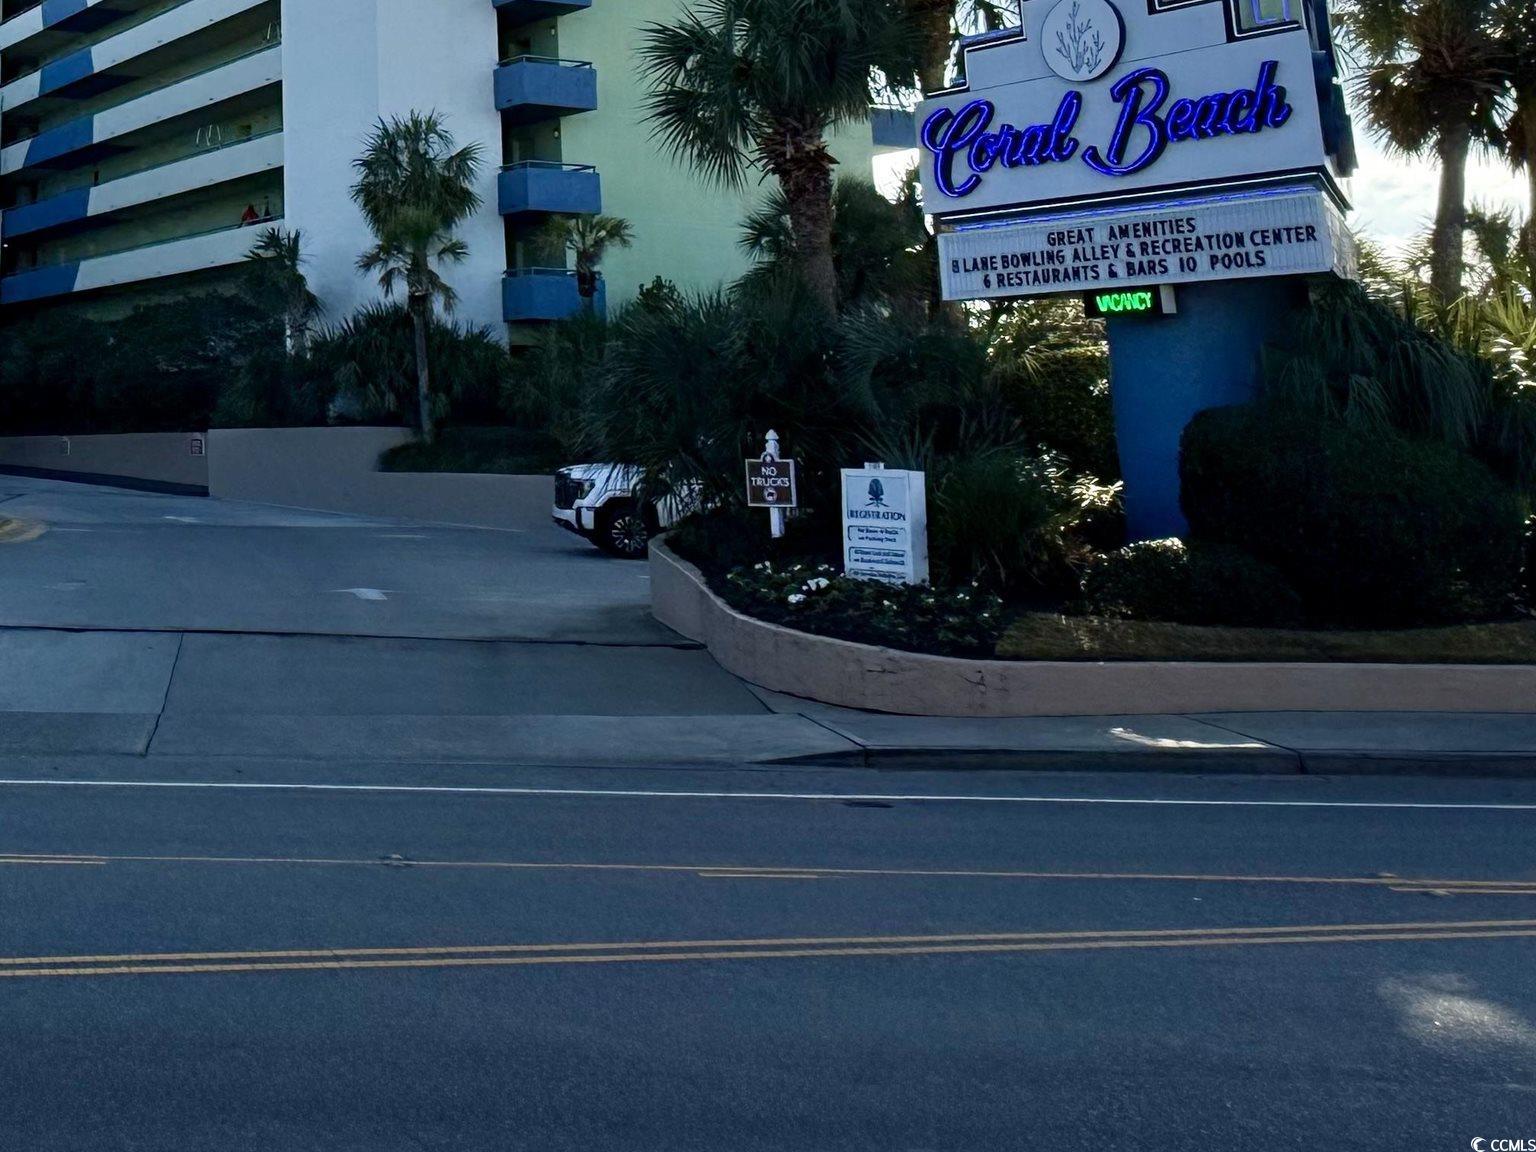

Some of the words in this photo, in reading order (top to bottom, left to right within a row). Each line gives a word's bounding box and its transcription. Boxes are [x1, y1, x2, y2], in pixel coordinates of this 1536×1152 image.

[921, 90, 1080, 197] Coral
[1082, 60, 1292, 176] Beach
[1047, 227, 1095, 246] GREAT
[1108, 217, 1196, 241] AMENITIES
[963, 255, 998, 273] LANE
[1001, 250, 1066, 269] BOWLING
[1072, 244, 1120, 263] ALLEY
[1125, 242, 1137, 258] &
[1140, 231, 1245, 257] RECREATION
[1249, 225, 1318, 247] CENTER
[983, 274, 991, 289] 6
[997, 265, 1100, 288] RESTAURANTS
[1107, 264, 1118, 279] &
[1126, 259, 1168, 276] BARS
[1179, 256, 1197, 273] 10
[1210, 250, 1266, 270] POOLS
[1096, 292, 1152, 312] VACANCY
[751, 477, 790, 487] TRUCKS
[761, 466, 777, 476] NO
